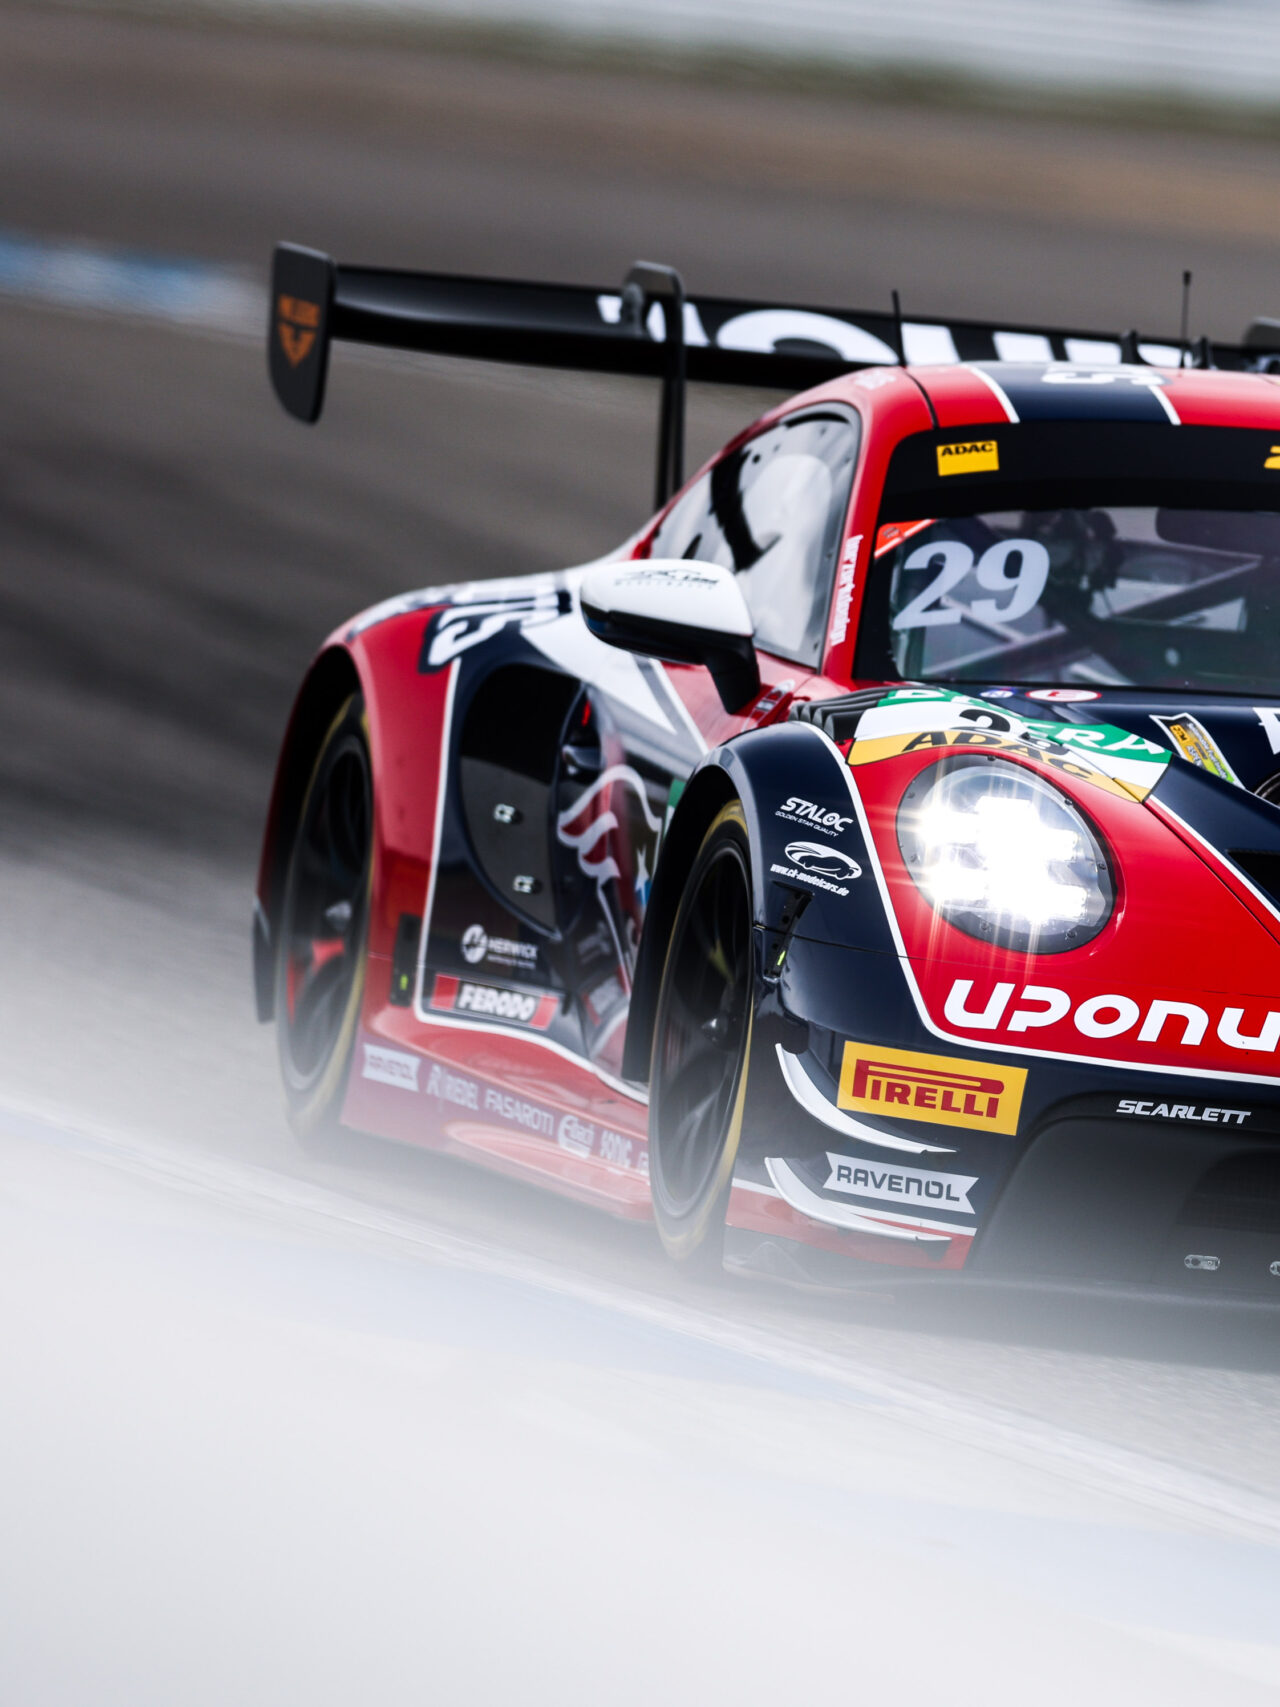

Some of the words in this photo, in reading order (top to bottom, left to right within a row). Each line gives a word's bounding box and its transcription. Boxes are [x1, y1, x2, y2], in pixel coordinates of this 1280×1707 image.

[940, 442, 995, 457] ADAC
[893, 538, 1050, 631] 29
[902, 731, 1093, 779] ADAC
[774, 810, 798, 823] GOLDEN
[797, 818, 814, 829] STAR
[813, 824, 839, 837] QUALITY
[780, 797, 854, 832] STALOC
[458, 983, 536, 1021] FERODO
[852, 1059, 1005, 1118] PIRELLI
[1116, 1100, 1252, 1125] SCARLETT
[837, 1164, 961, 1203] RAVENOL
